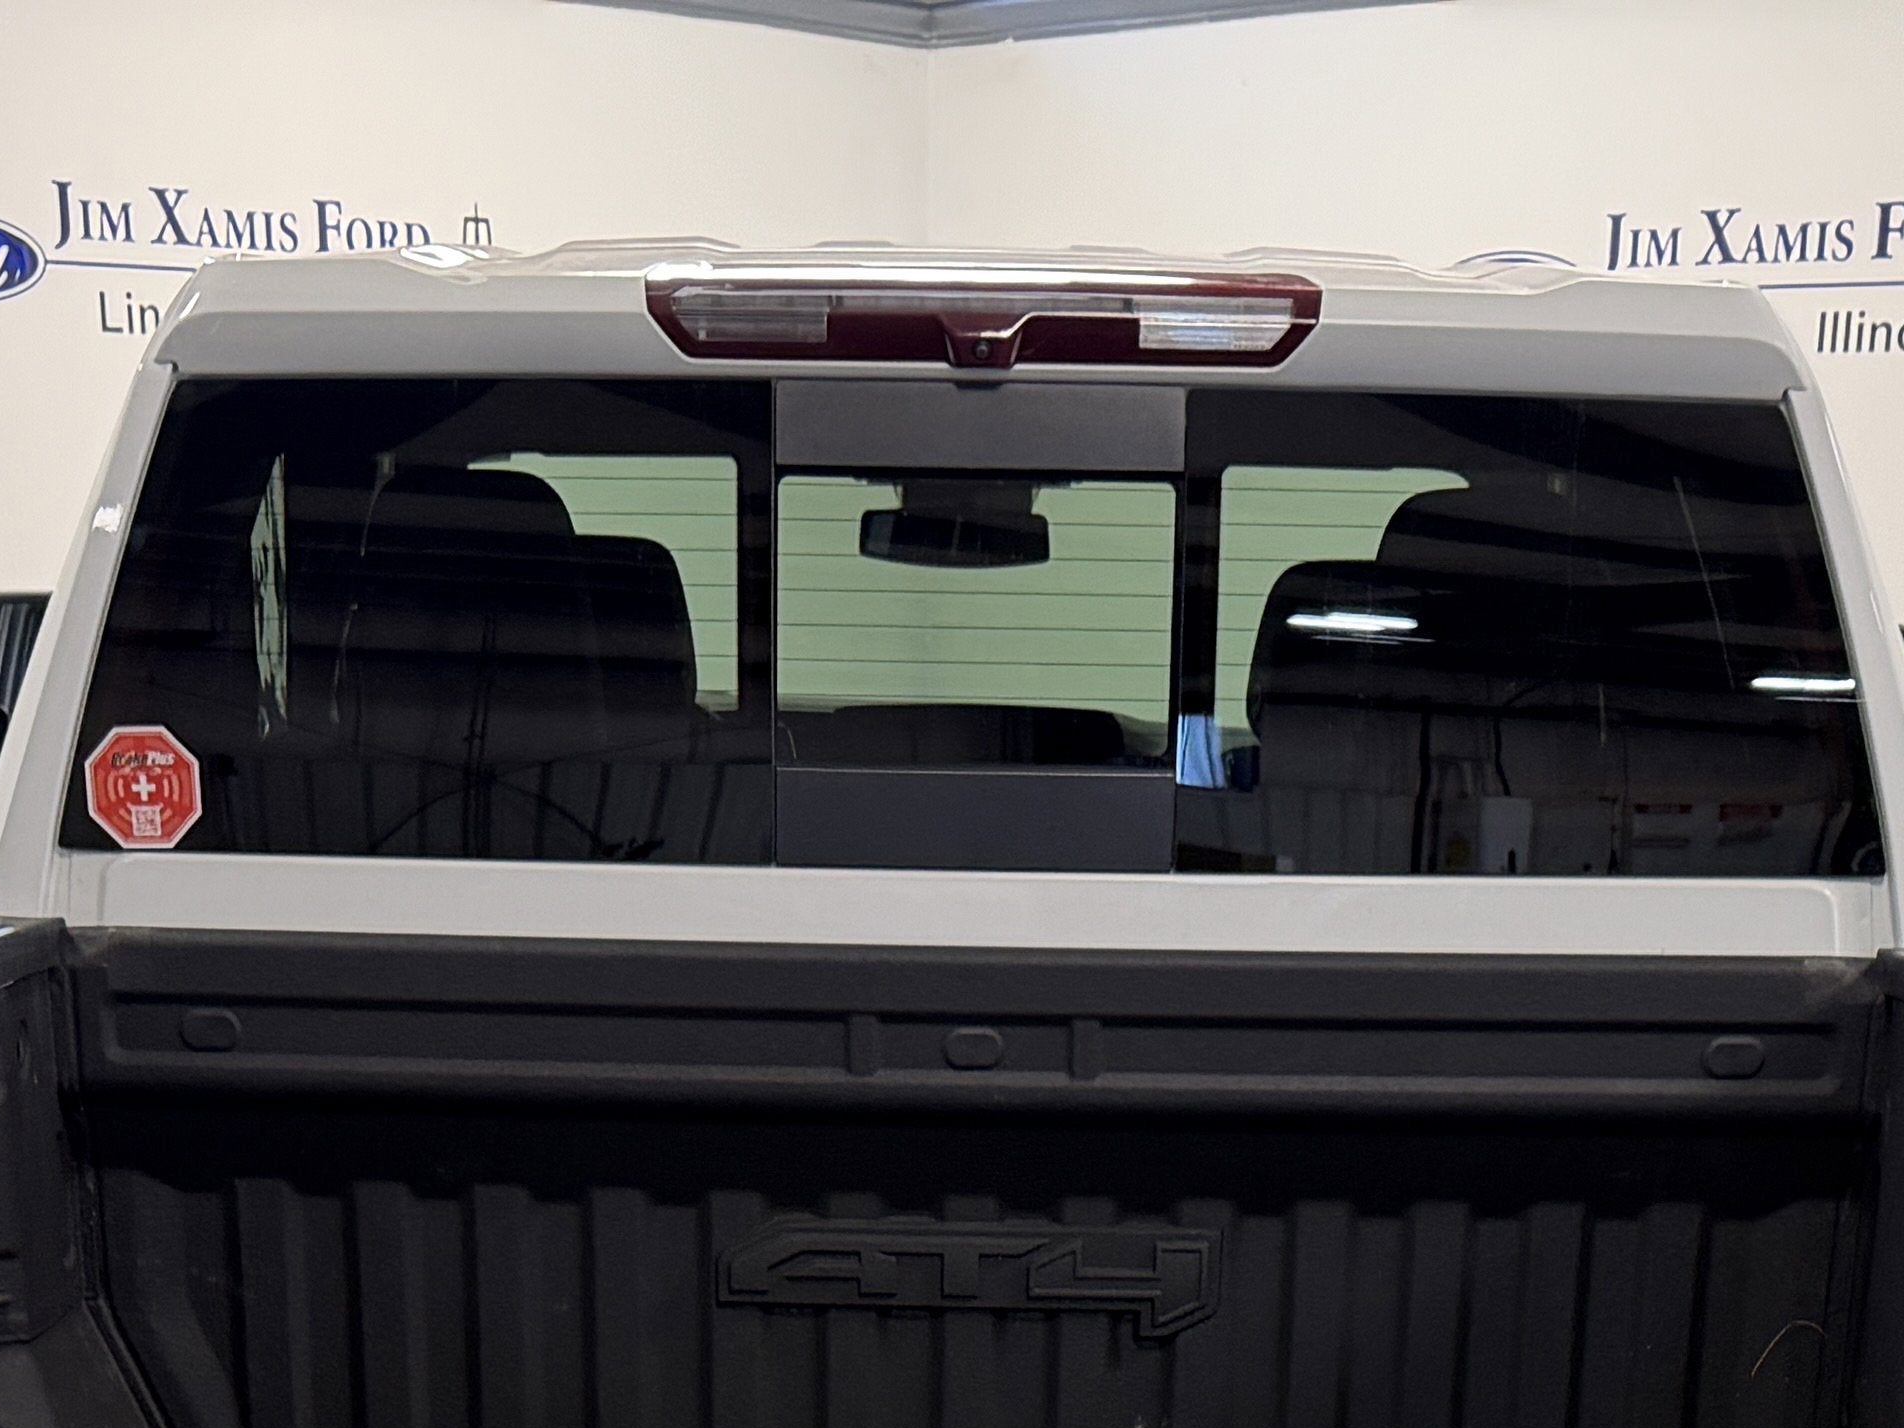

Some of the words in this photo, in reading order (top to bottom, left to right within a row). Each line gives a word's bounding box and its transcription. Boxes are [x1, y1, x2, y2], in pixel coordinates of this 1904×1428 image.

[51, 179, 135, 249] JIM
[148, 186, 298, 253] XAMIS
[1606, 212, 1682, 270] JIM
[1695, 207, 1856, 266] XAMIS
